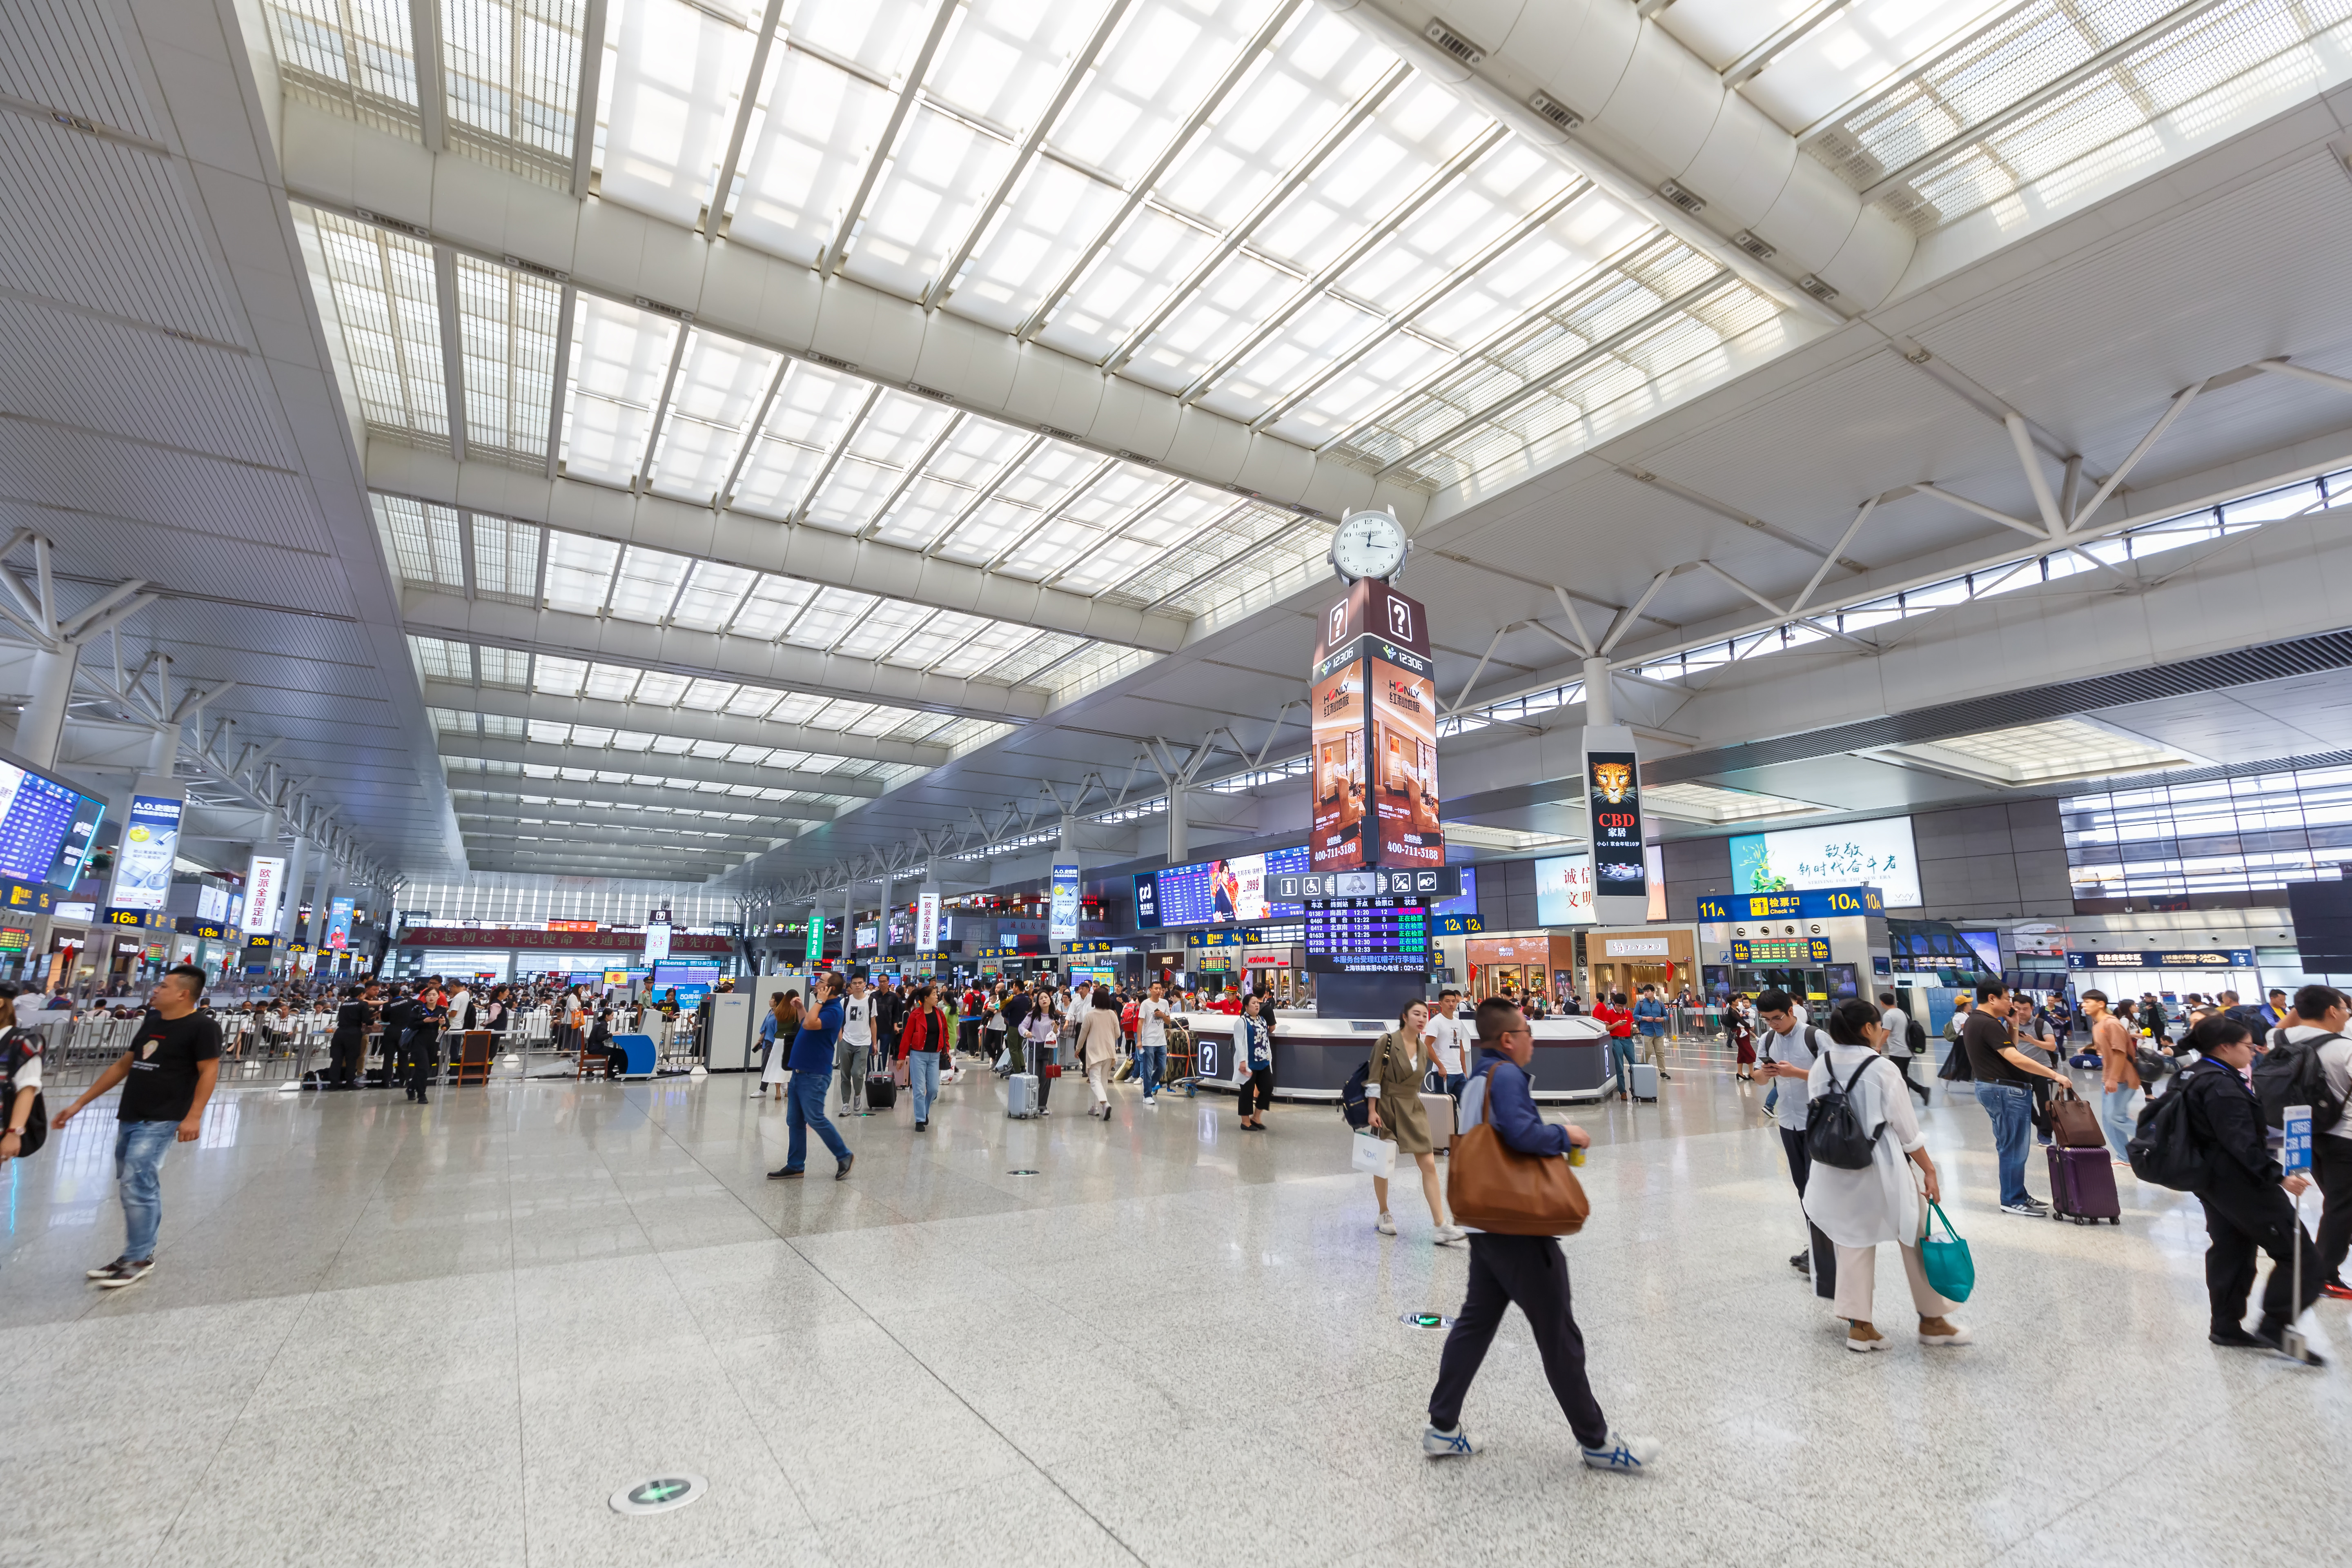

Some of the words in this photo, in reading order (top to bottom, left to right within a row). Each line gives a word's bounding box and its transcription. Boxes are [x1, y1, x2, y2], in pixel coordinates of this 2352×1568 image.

[1333, 647, 1354, 668] 12306
[1399, 653, 1423, 671] 12306
[1324, 682, 1349, 704] HONLY
[1389, 680, 1419, 699] HONLY
[1324, 694, 1349, 717] 红利地板
[1389, 692, 1420, 714] 红利地板
[1599, 813, 1635, 827] CBD
[1608, 827, 1626, 837] 家居
[1314, 842, 1356, 862] 400-711-3188
[1387, 841, 1438, 860] 400-711-3188
[1825, 842, 1863, 859] 致敬
[1797, 854, 1896, 878] 新时代奋斗者
[1247, 879, 1259, 890] 7999
[251, 869, 271, 926] 欧派全屋定制
[1769, 897, 1800, 907] 检票口
[1828, 893, 1860, 910] 10A
[1865, 893, 1881, 910] 10A
[1700, 902, 1725, 917] 11A
[111, 912, 138, 924] 16B
[922, 902, 932, 944] 欧派全屋定制
[1445, 919, 1461, 931] 12A
[1466, 919, 1481, 931] 12A
[198, 927, 218, 937] 18B
[423, 930, 494, 942] 不忘初心
[506, 932, 573, 944] 牢记使命
[585, 934, 646, 947] 交通强国
[672, 937, 716, 948] 路先行
[1191, 935, 1199, 944] 15A
[1232, 933, 1241, 942] 14A
[1245, 933, 1259, 942] 14A
[252, 937, 270, 945] 20B
[1734, 943, 1748, 952] 11A
[1811, 941, 1827, 950] 10A
[1333, 956, 1424, 964] 本服务台受理红帽子行李搬运
